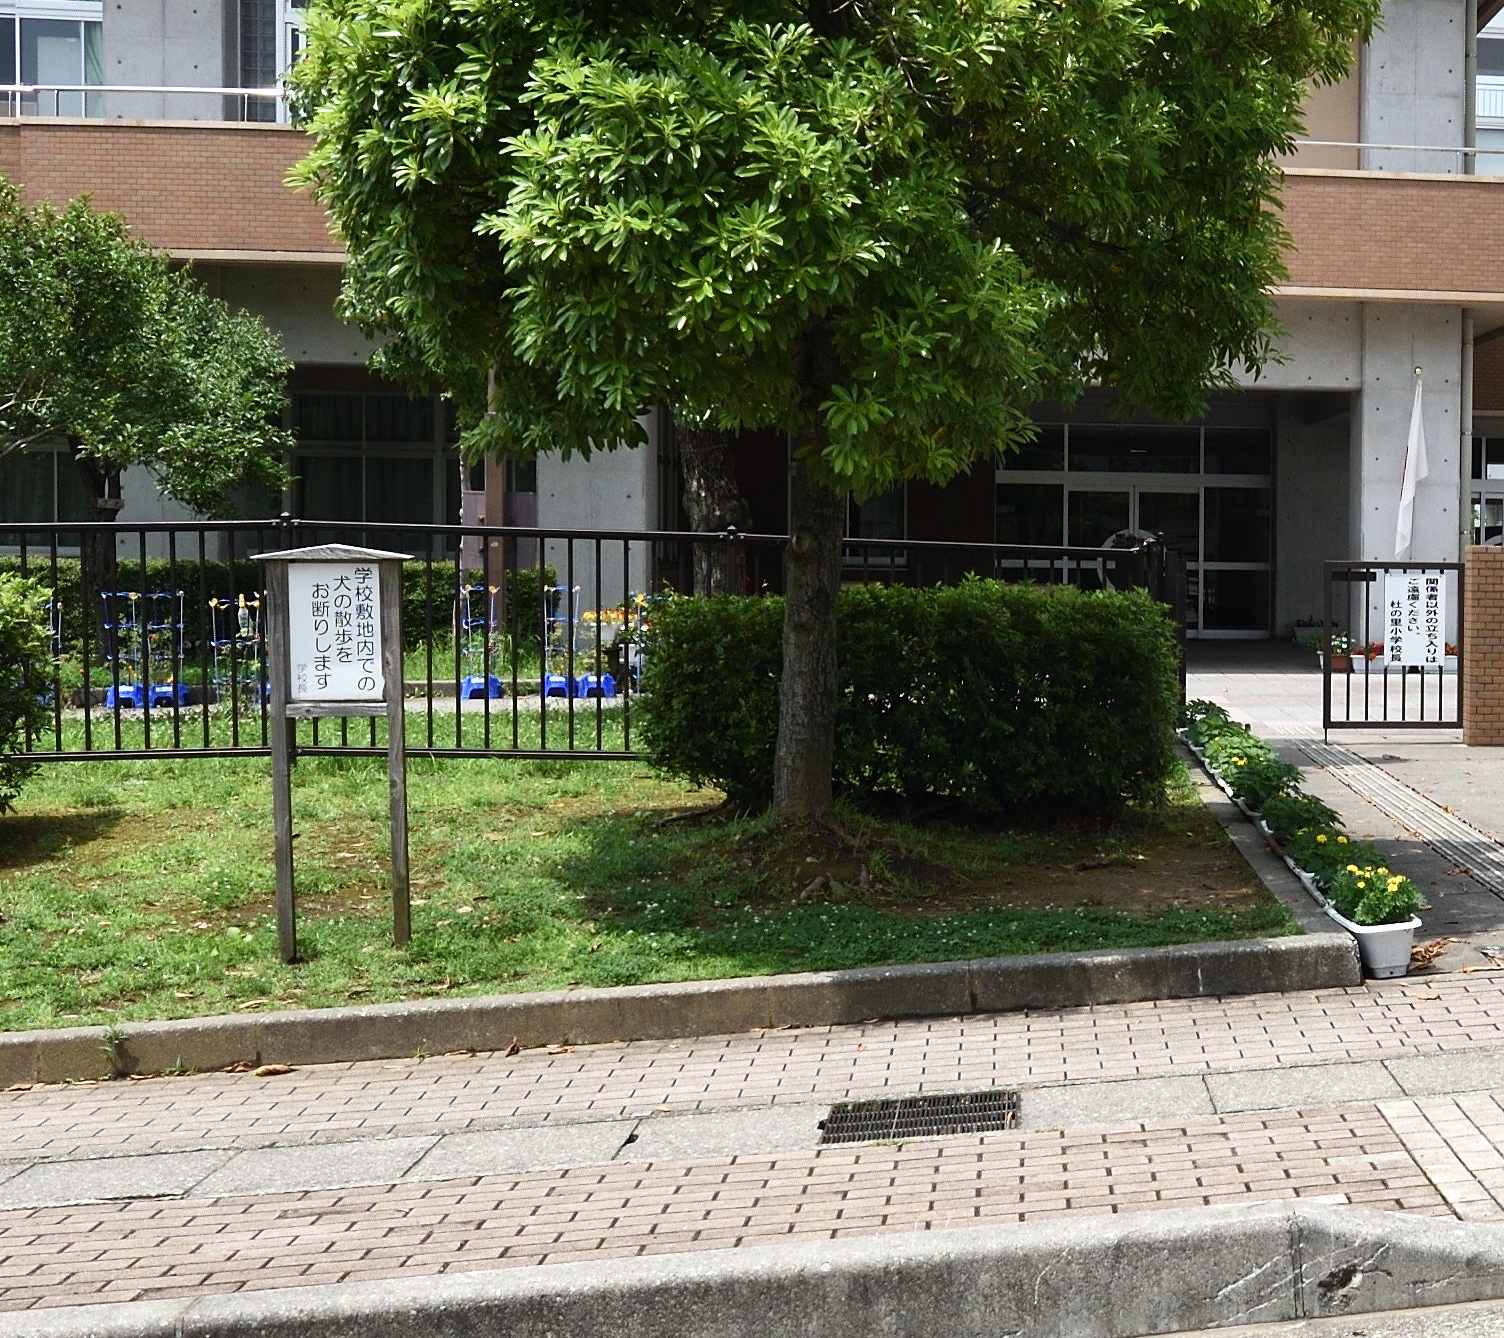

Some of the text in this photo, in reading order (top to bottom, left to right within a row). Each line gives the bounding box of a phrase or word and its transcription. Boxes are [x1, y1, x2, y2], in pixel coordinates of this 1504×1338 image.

[311, 582, 331, 690] お断りします
[333, 574, 353, 664] 犬の散歩を
[354, 566, 376, 692] 学校敷地内での
[1389, 599, 1403, 662] 杜の里小学校長
[1425, 577, 1439, 663] 関係者以外の立ち入りは
[296, 663, 308, 693] 学校長
